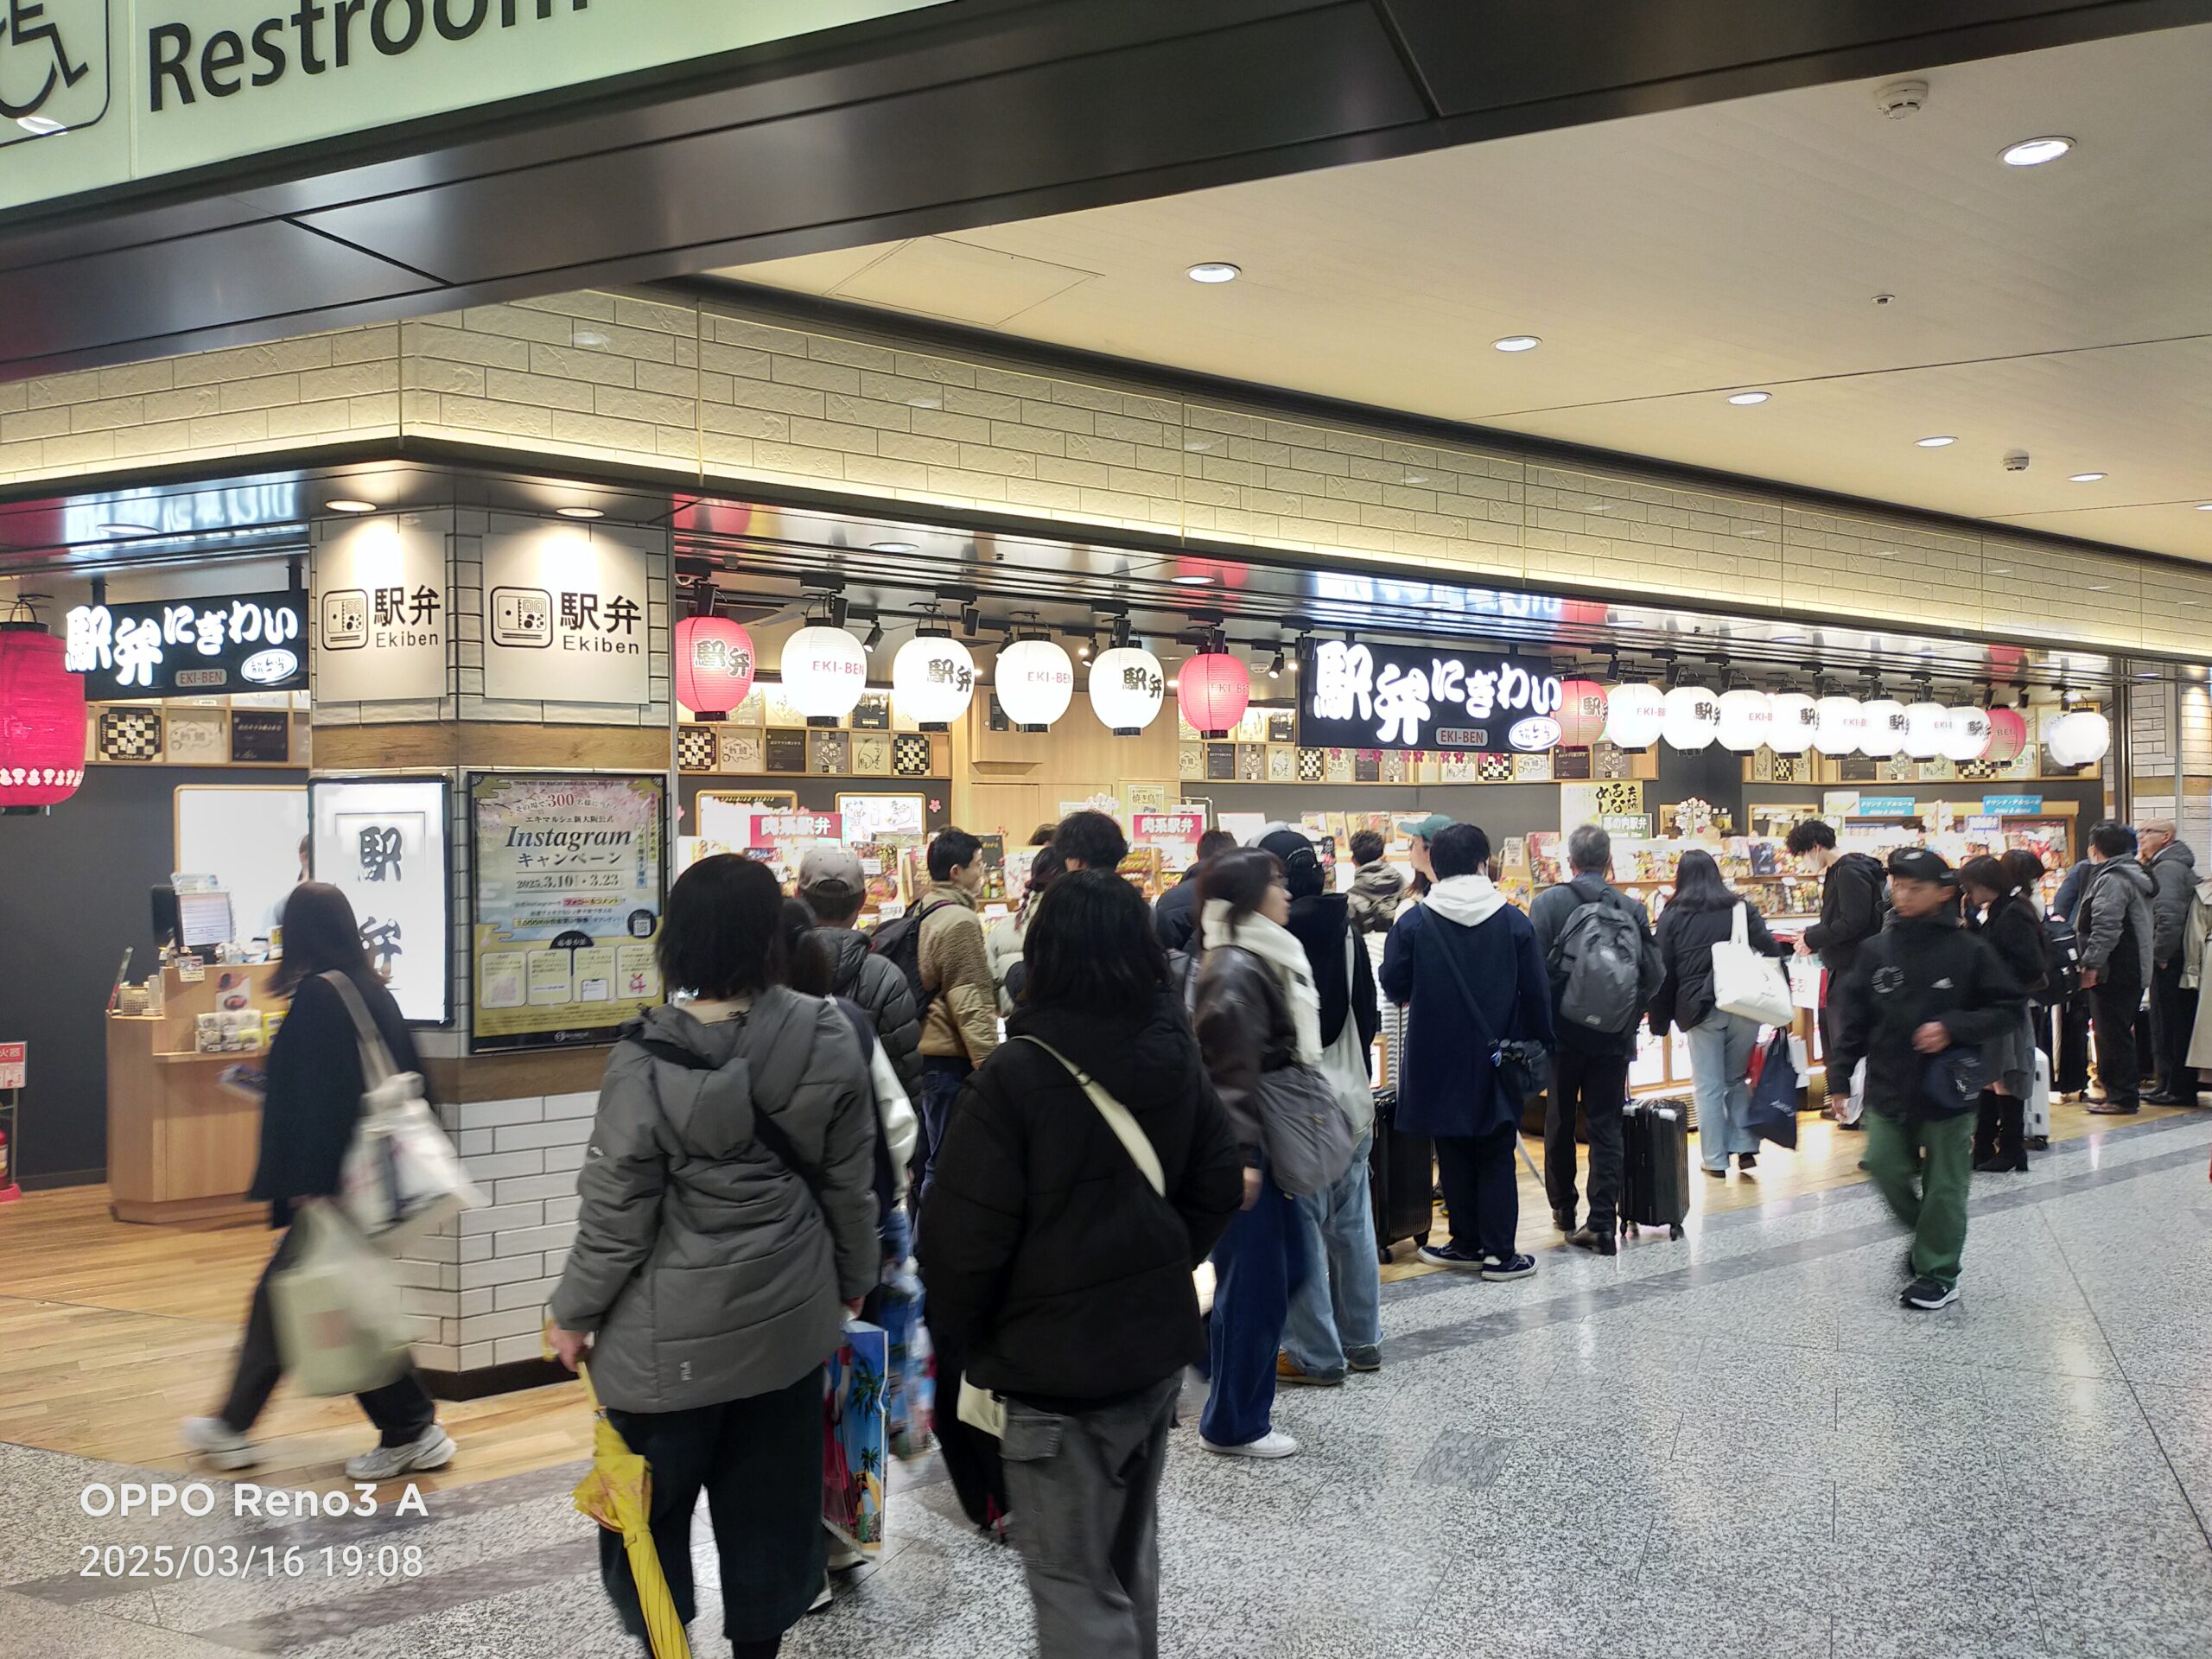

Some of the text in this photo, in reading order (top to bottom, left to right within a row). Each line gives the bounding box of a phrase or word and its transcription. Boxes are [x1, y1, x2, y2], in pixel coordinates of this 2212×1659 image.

[374, 585, 441, 626] 駅弁
[561, 592, 642, 634] 駅弁
[66, 601, 298, 686] 駅弁にぎわい
[377, 631, 439, 648] Ekiben
[563, 635, 639, 655] Ekiben
[695, 640, 750, 678] 駅弁
[812, 660, 864, 676] EKI-BEN
[927, 658, 973, 693] 駅弁
[180, 671, 223, 684] EKI-BEN
[1027, 671, 1071, 683] EKI-BEN
[1122, 667, 1162, 699] 駅弁
[1211, 683, 1250, 695] EKIBE
[1313, 641, 1563, 746] 駅弁にぎわい
[1637, 707, 1667, 717] EKI-BE
[1748, 712, 1773, 721] EKI-B
[1842, 718, 1867, 727] EKI-B
[1440, 729, 1484, 744] EKI-BEN
[760, 816, 832, 836] 肉系駅弁
[1141, 817, 1194, 834] 肉系駅弁
[505, 825, 631, 852] Instagram
[518, 852, 622, 868] キャンペーン
[358, 825, 403, 977] 駅弁
[0, 1047, 21, 1058] 火器
